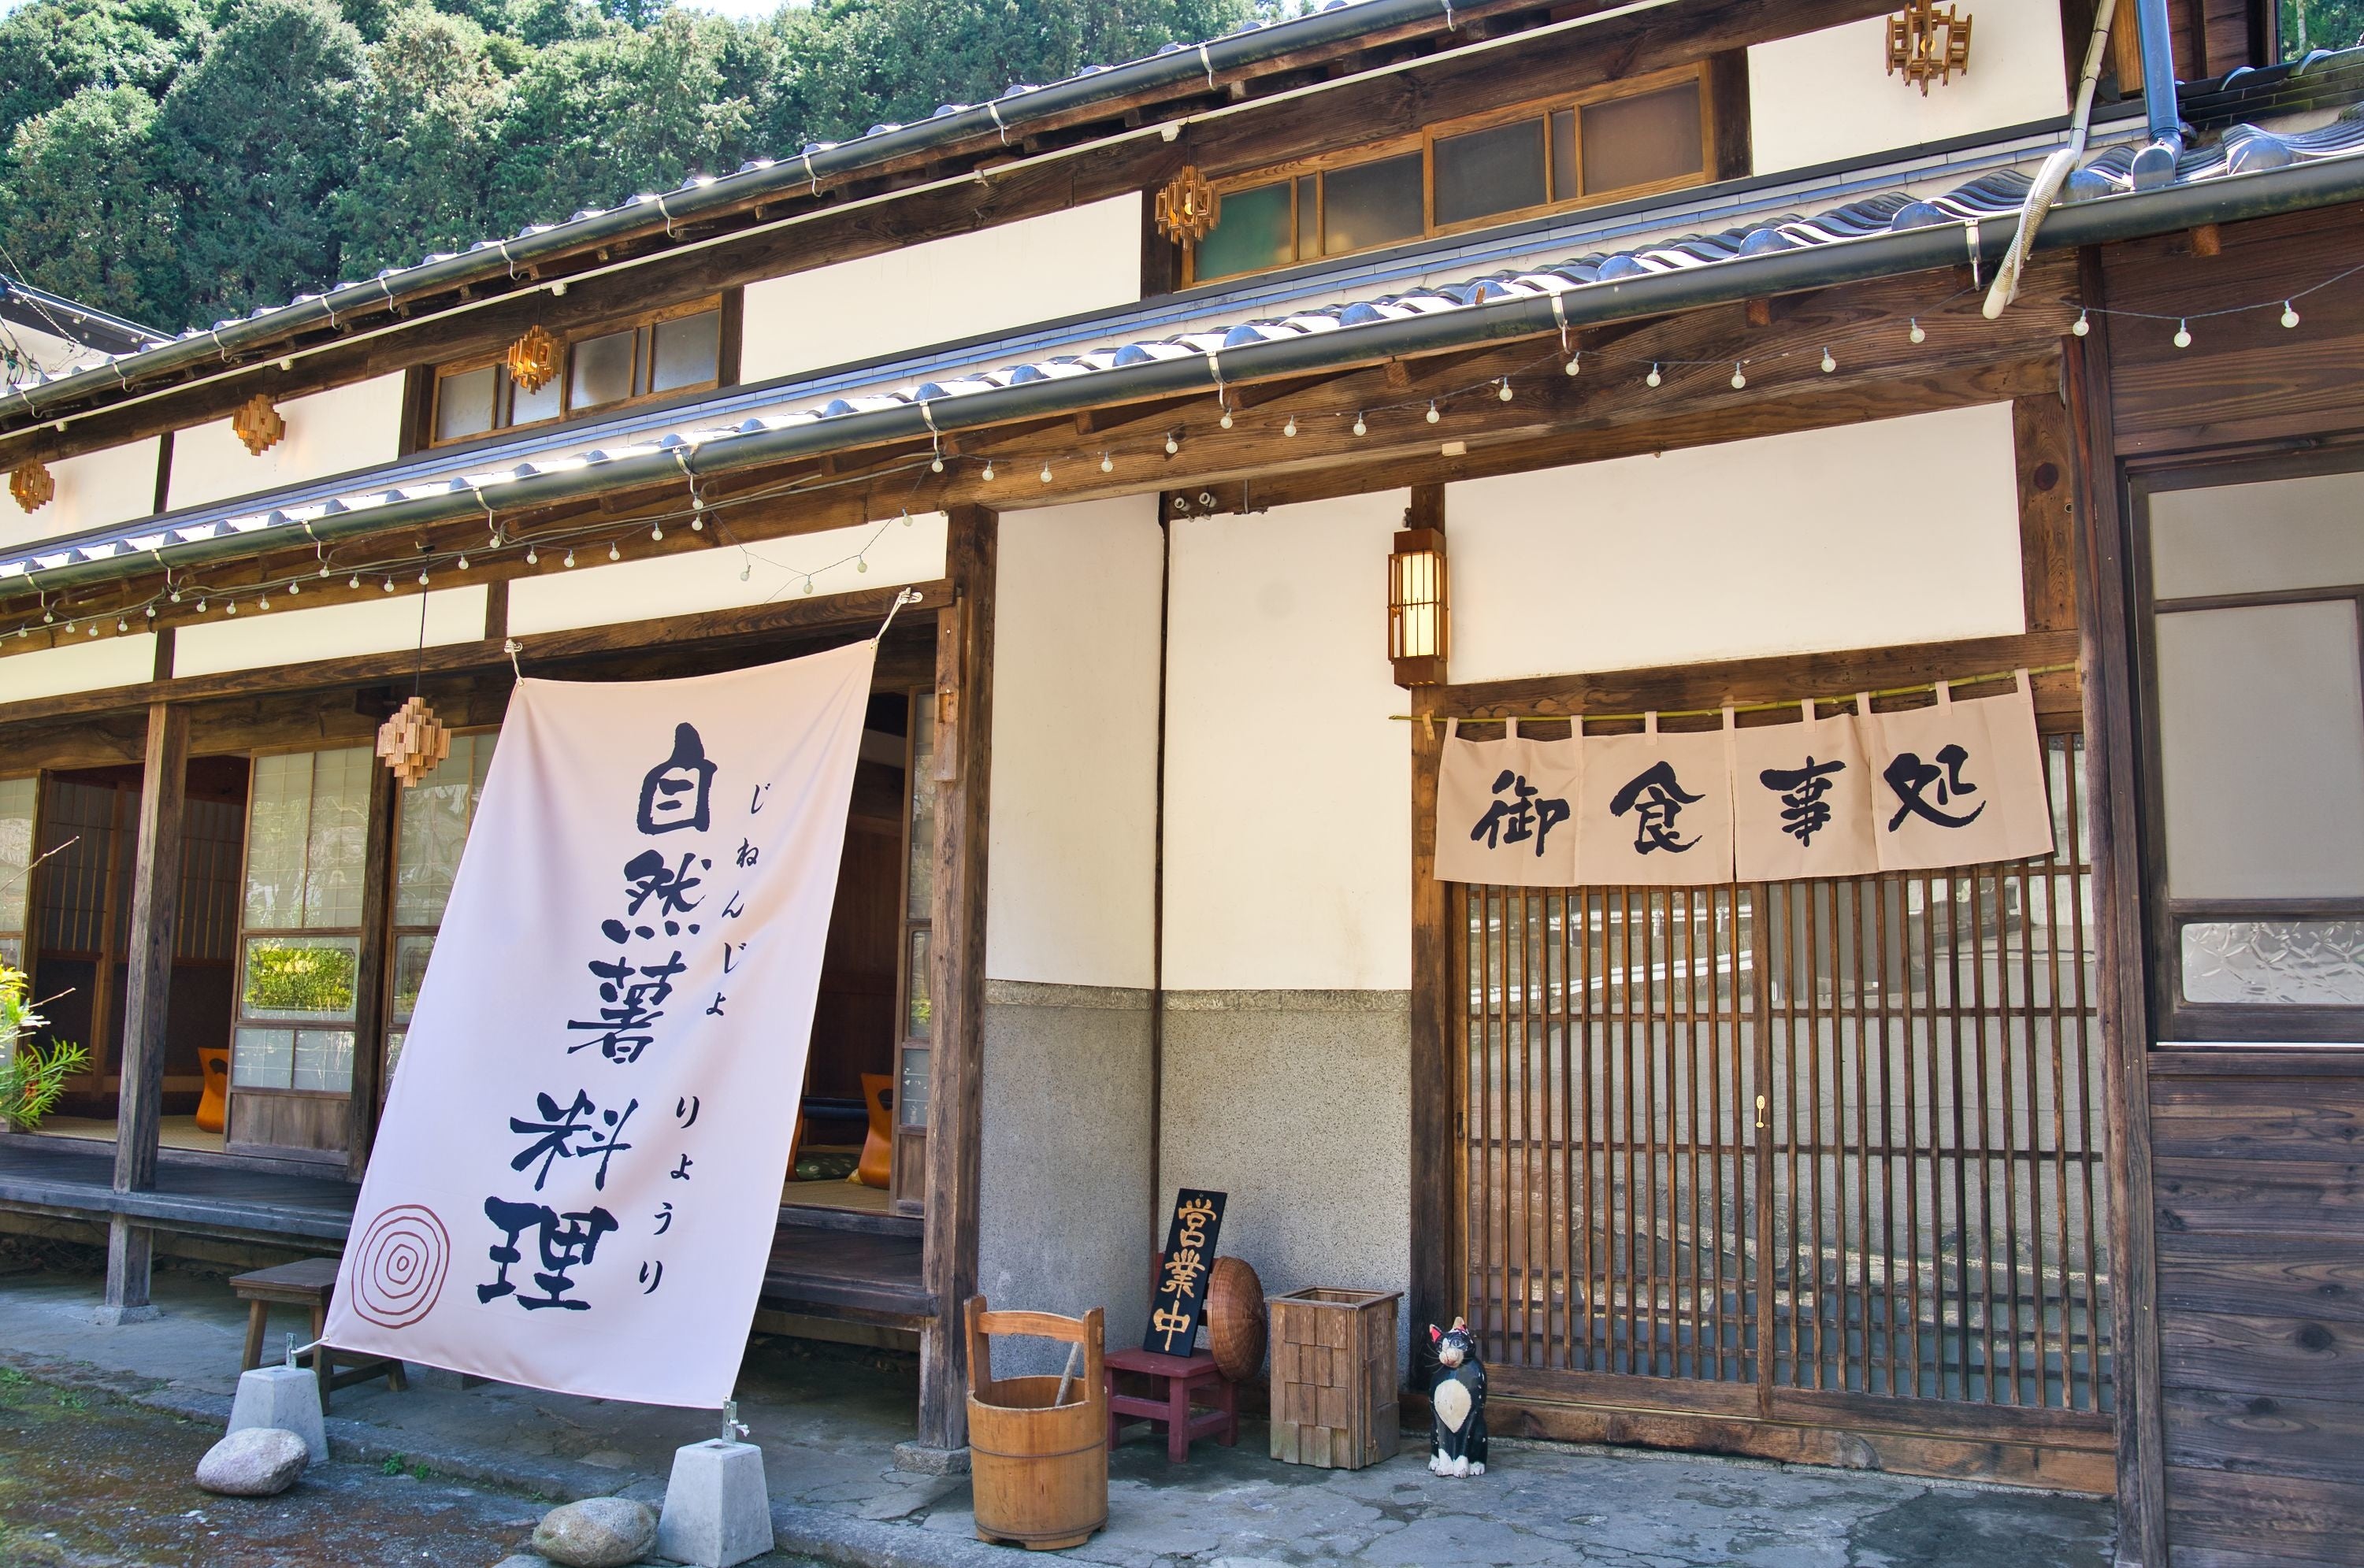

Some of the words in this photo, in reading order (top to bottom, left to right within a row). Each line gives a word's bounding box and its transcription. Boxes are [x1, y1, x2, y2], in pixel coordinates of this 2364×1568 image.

[1471, 744, 1987, 858] 御食事処
[1153, 1198, 1217, 1352] 営業中
